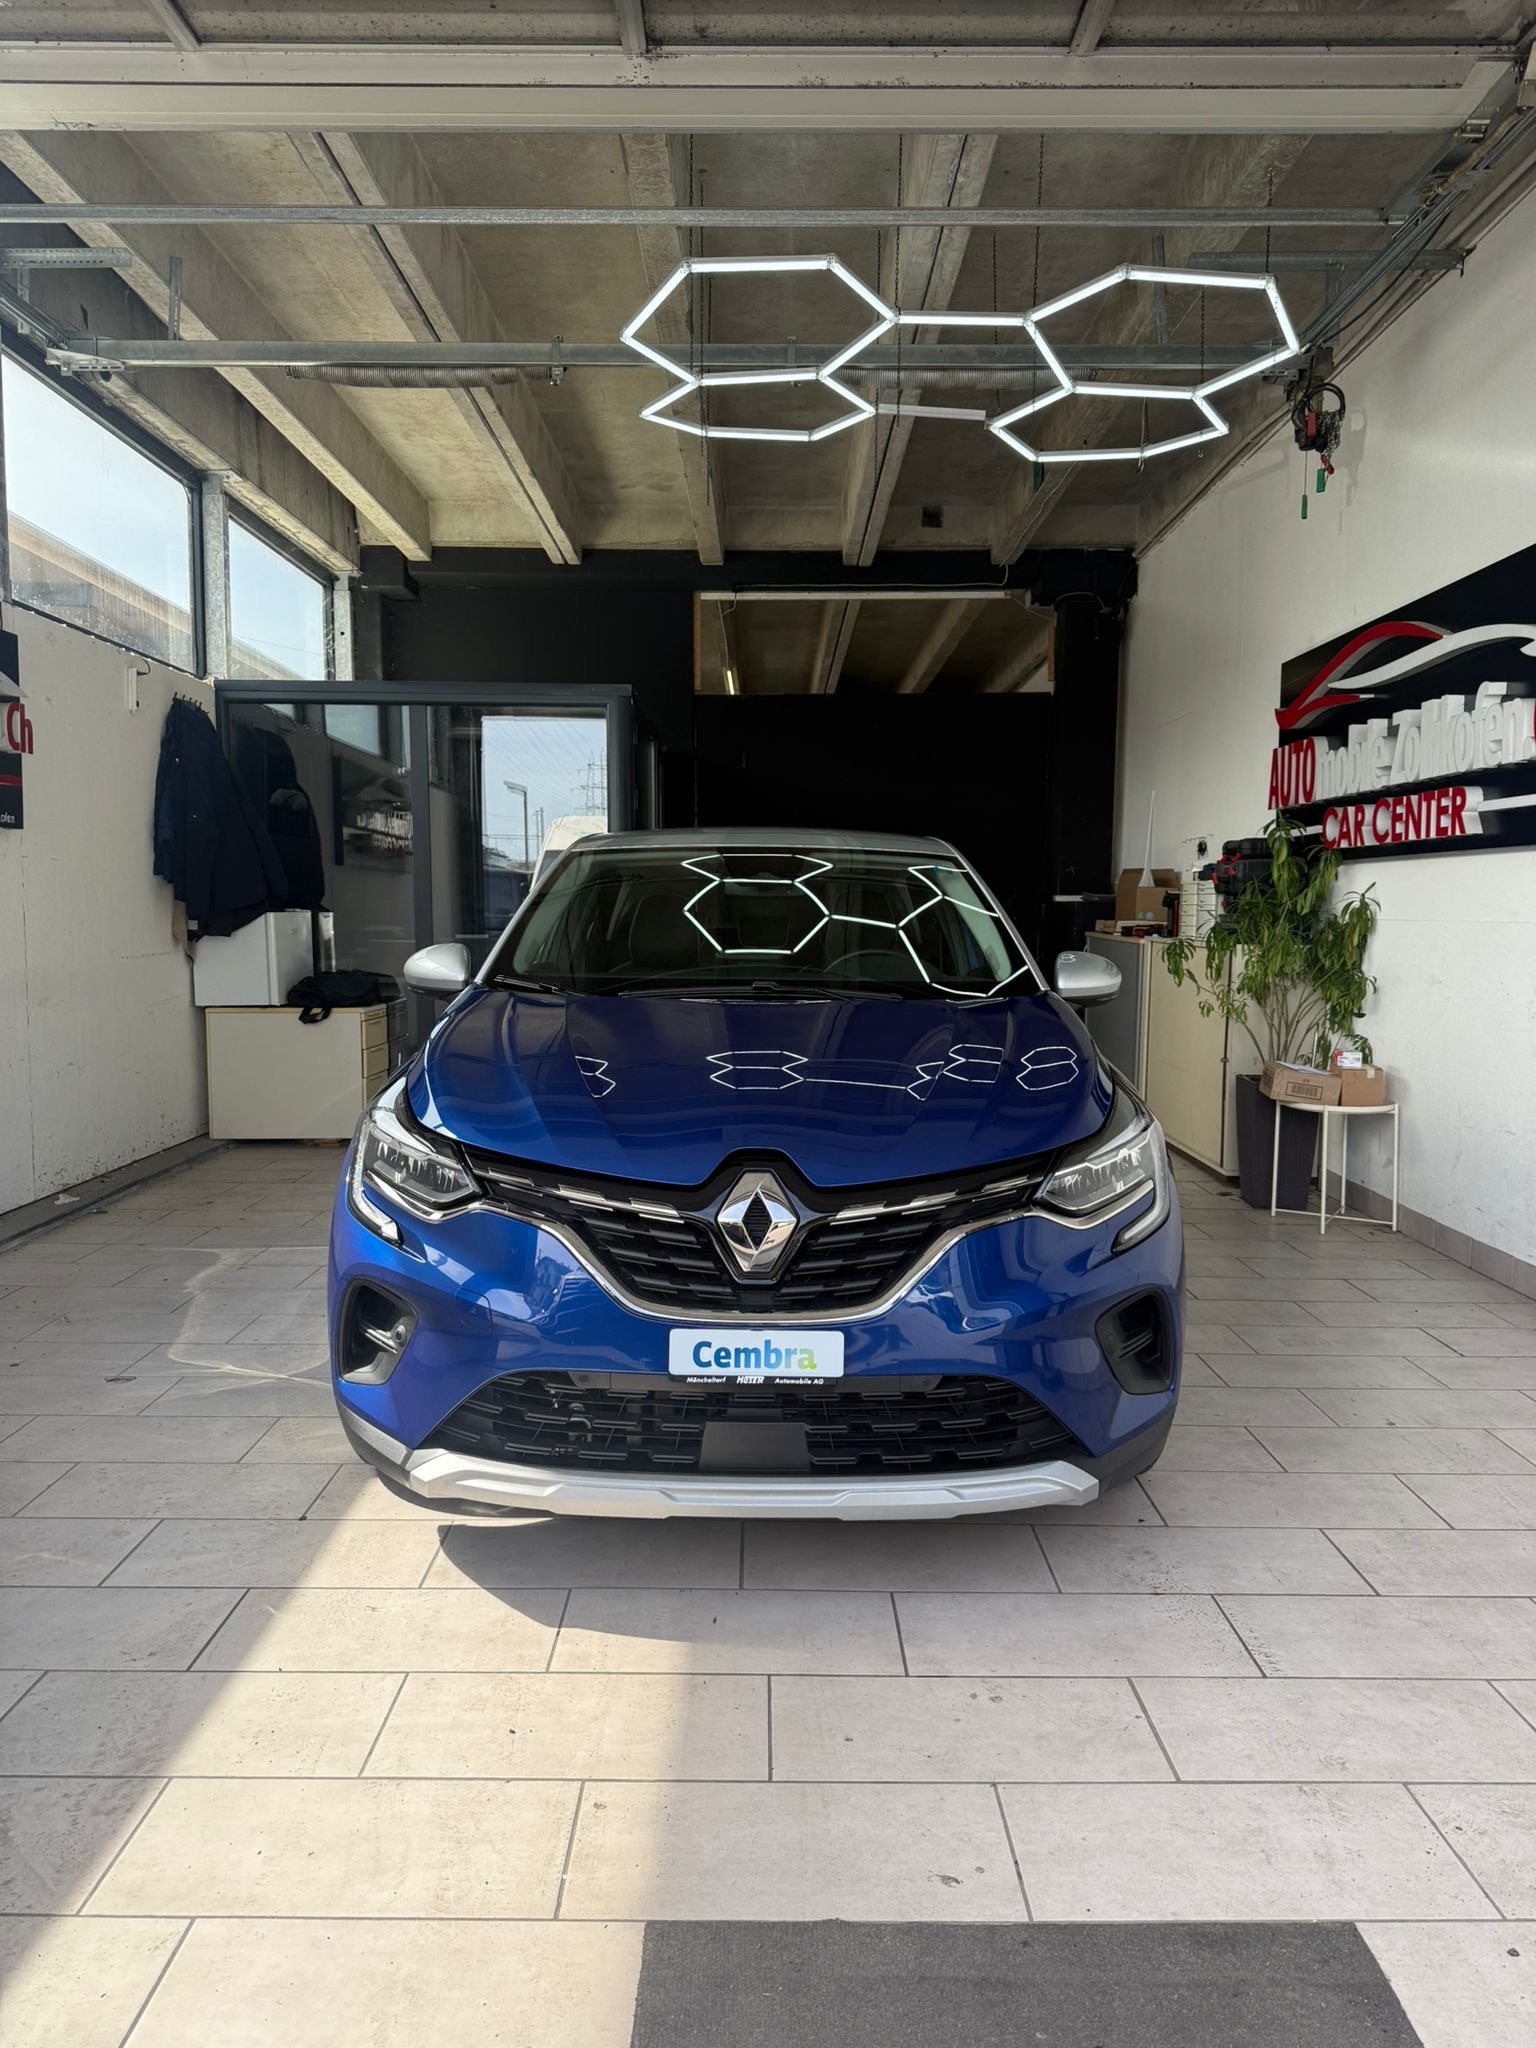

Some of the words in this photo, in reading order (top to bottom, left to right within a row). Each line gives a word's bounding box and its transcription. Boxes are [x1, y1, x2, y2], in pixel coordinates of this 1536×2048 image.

[1321, 804, 1365, 849] CAR
[1372, 786, 1467, 845] CENTER
[692, 1339, 817, 1370] Cembra
[774, 1377, 812, 1385] Automobile
